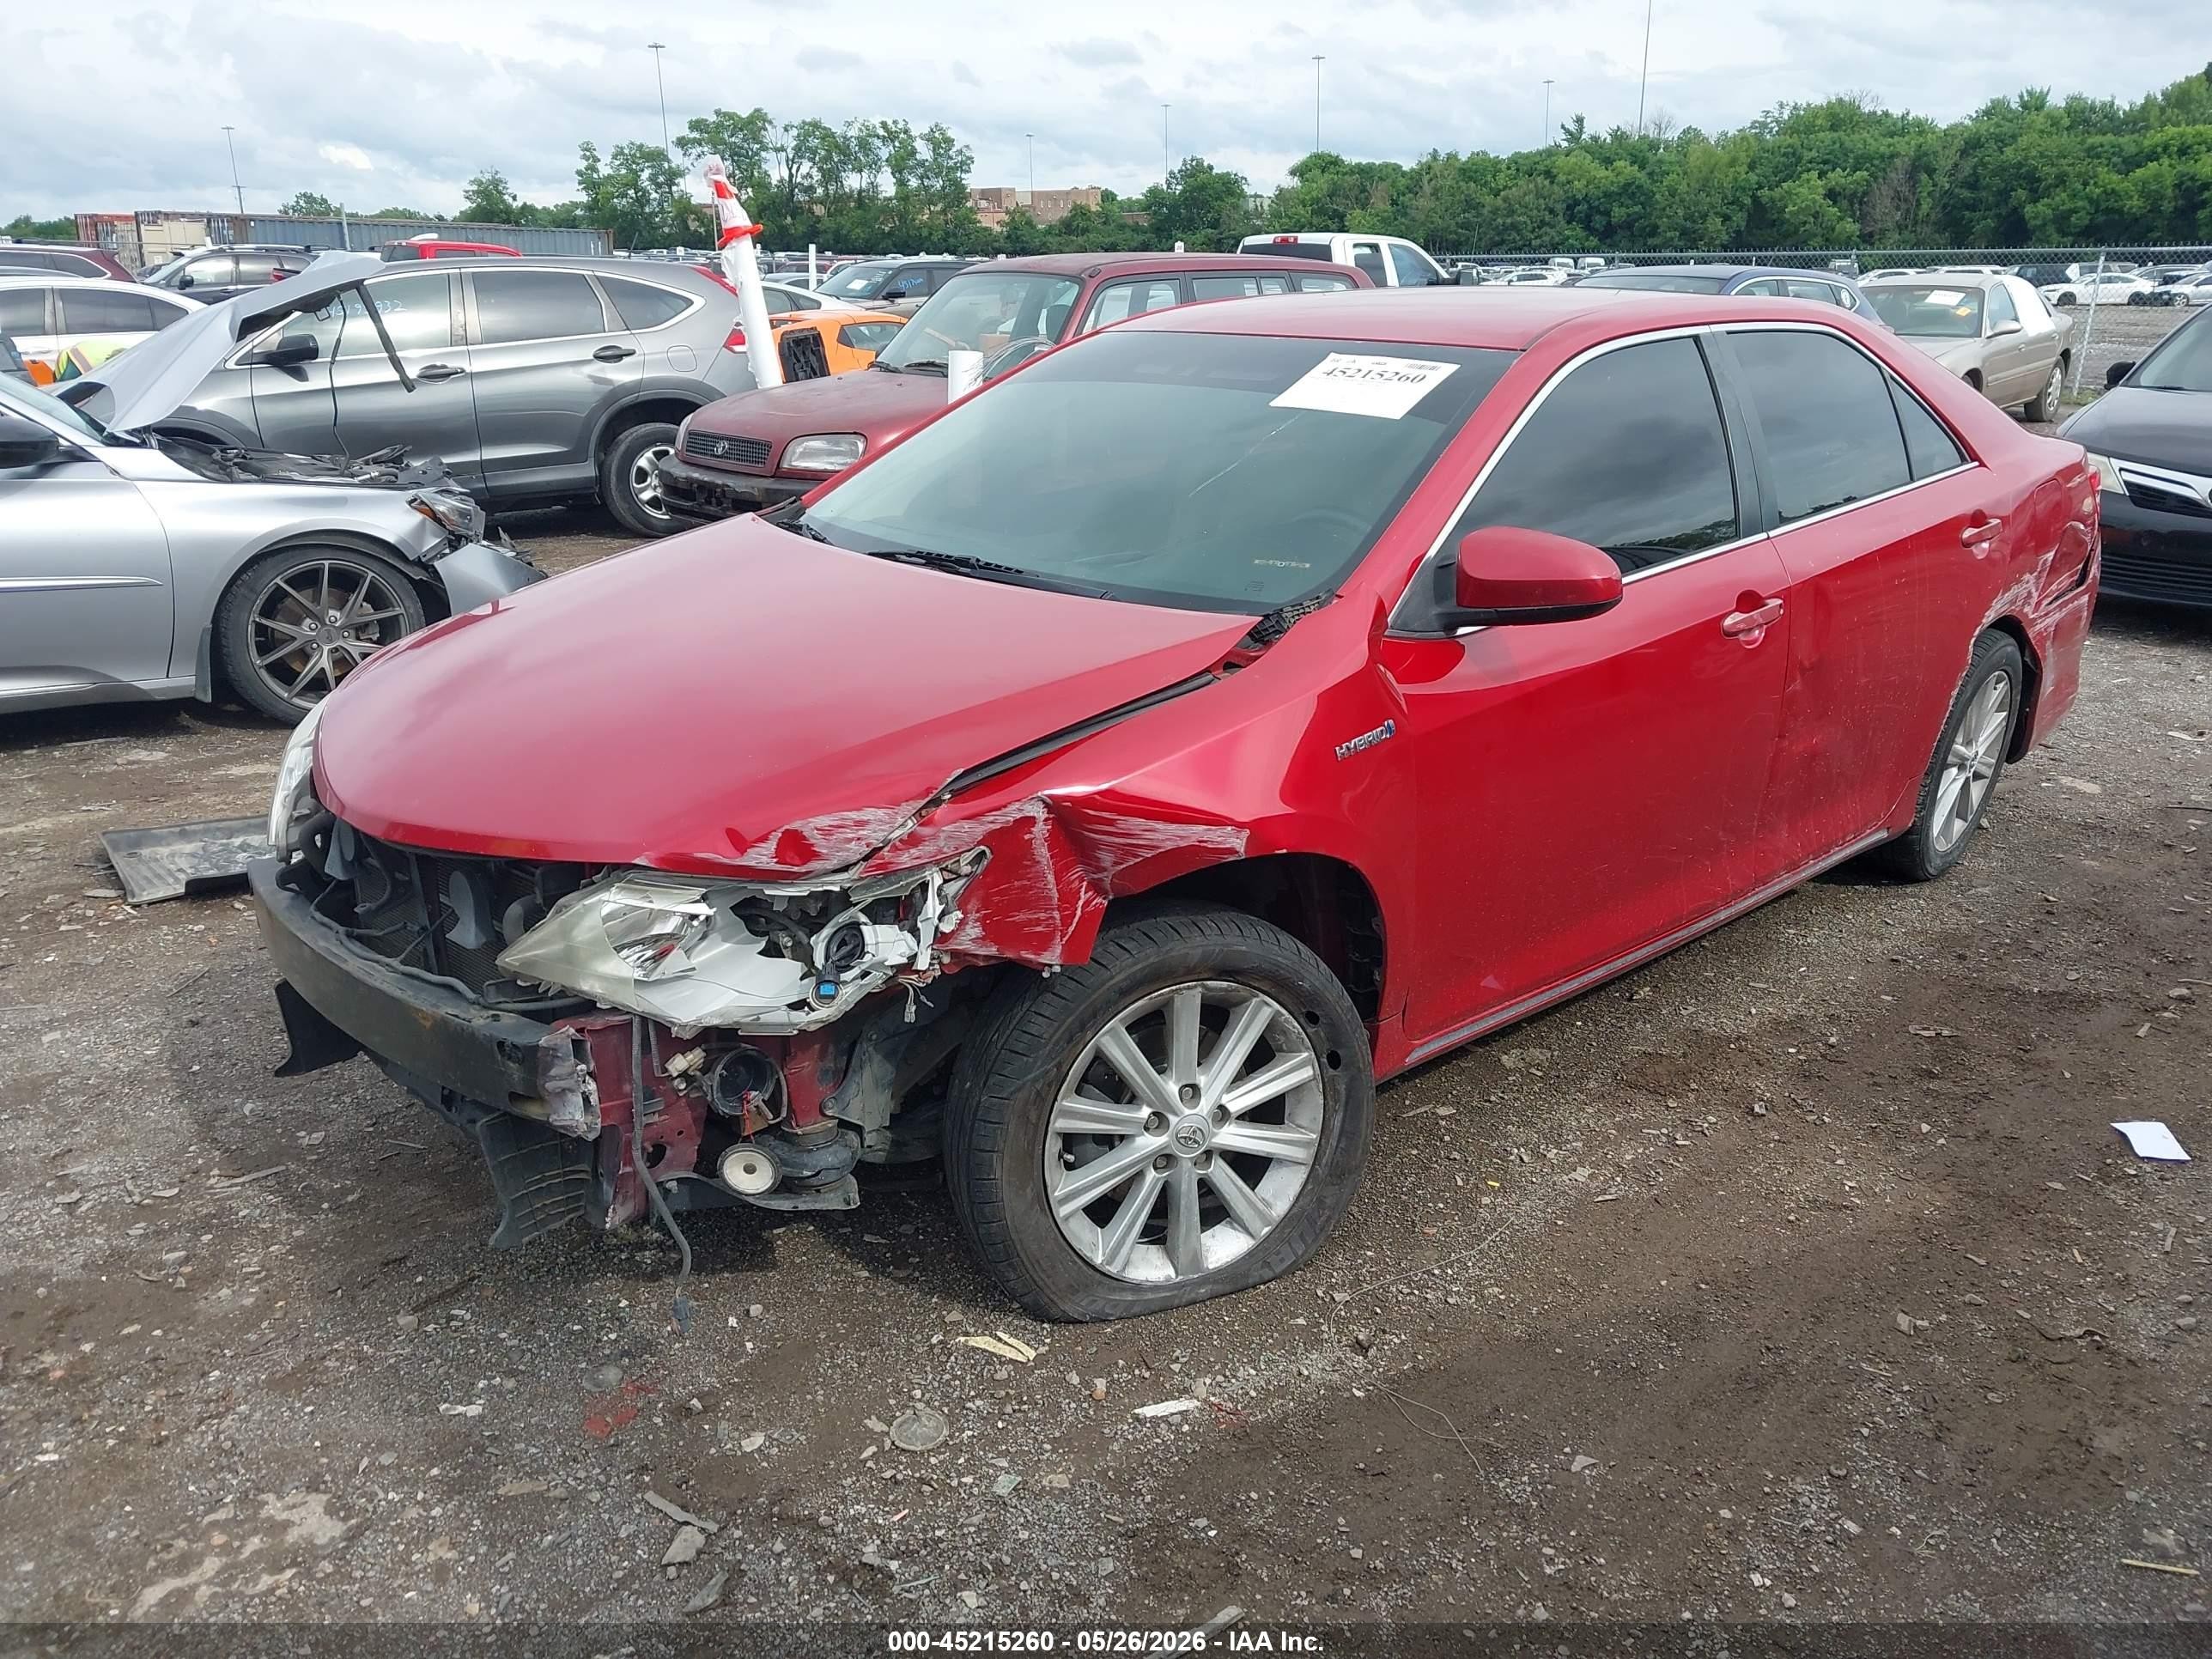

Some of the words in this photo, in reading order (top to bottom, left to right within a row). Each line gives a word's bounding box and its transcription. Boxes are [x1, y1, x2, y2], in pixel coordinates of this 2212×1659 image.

[328, 300, 407, 318] 4519932
[1322, 367, 1427, 384] 45215260
[1335, 726, 1387, 761] HYBRID
